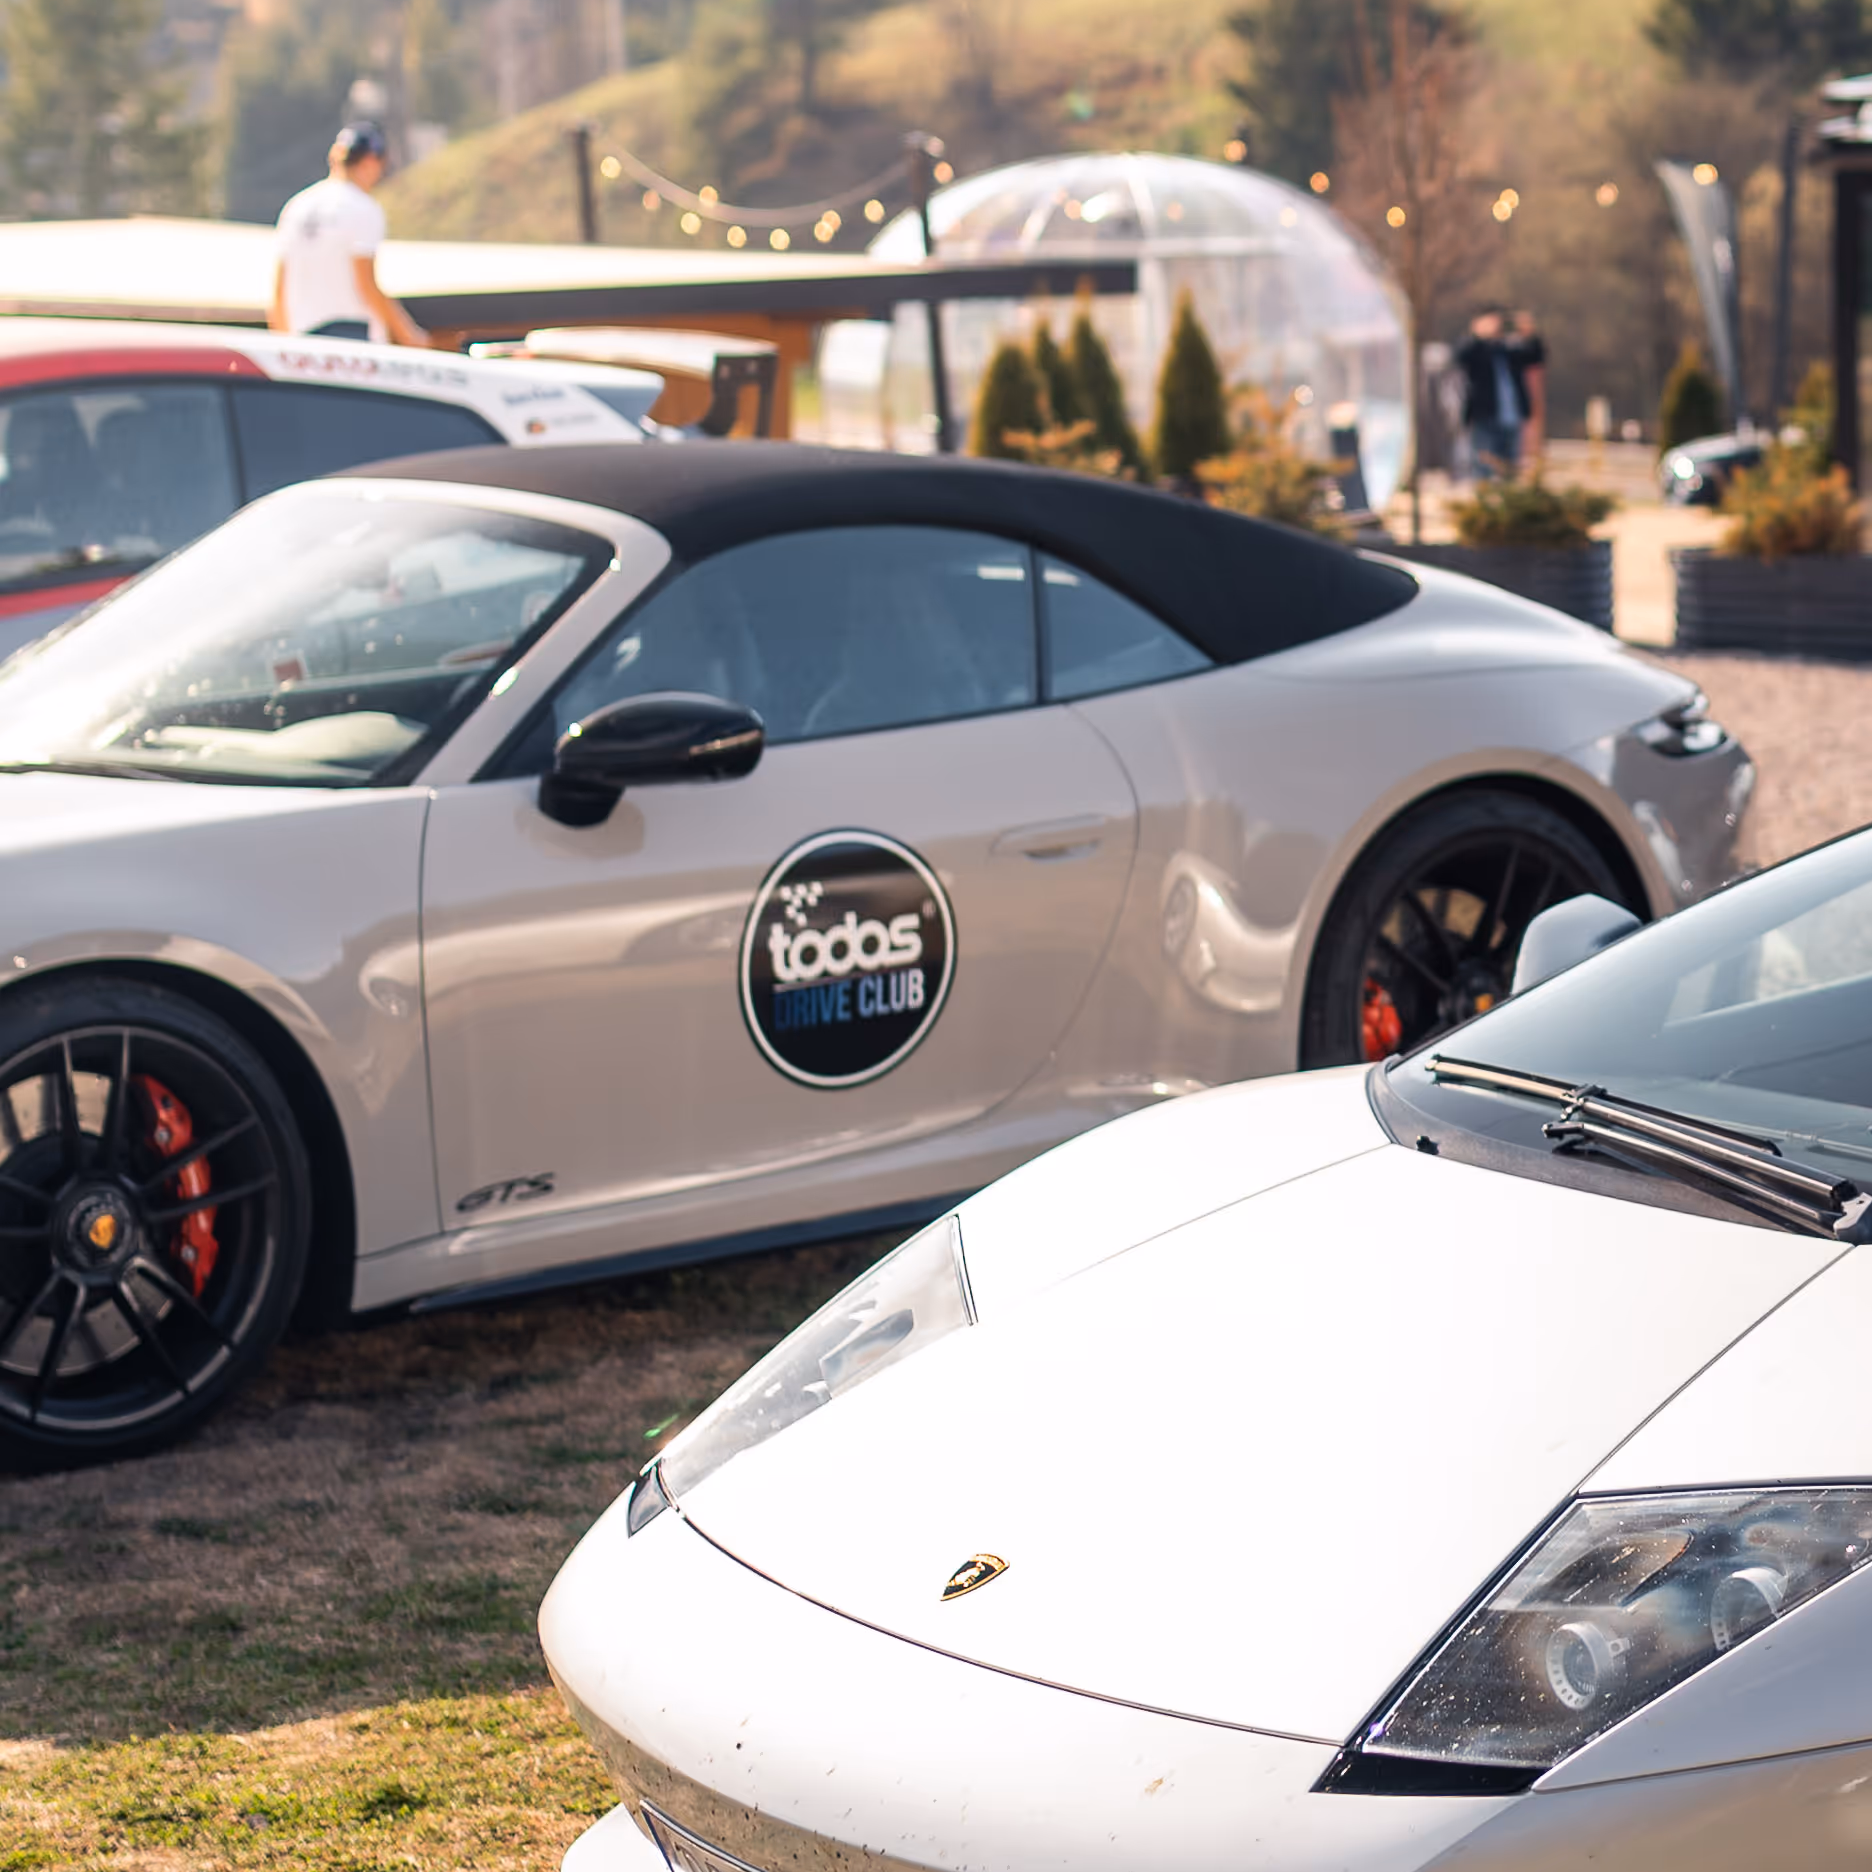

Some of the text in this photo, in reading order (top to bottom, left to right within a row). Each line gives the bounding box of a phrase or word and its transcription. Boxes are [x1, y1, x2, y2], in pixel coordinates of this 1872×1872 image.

[768, 910, 923, 982] todos
[773, 968, 924, 1031] DRIVE CLUB
